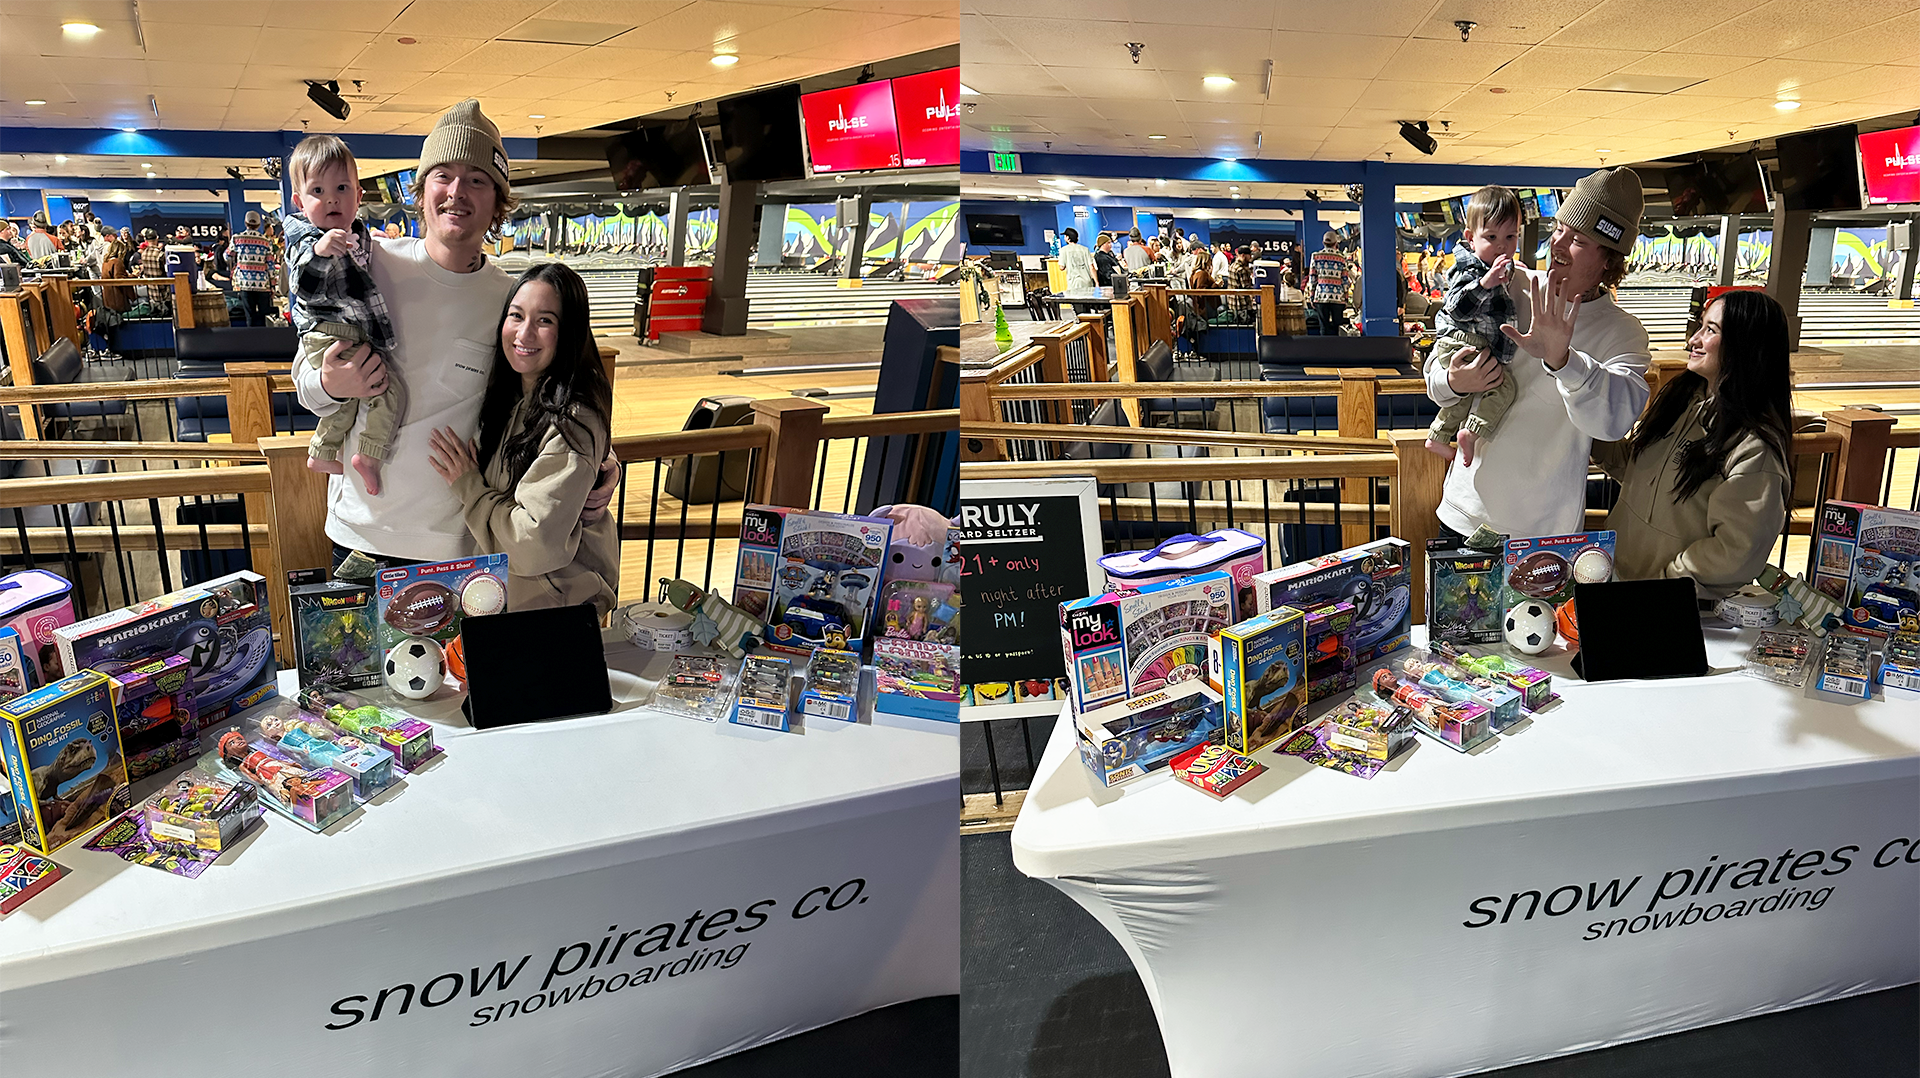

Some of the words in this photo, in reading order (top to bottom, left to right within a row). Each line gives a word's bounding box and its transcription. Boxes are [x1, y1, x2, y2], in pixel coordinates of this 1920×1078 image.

[829, 104, 868, 133] PULSE
[890, 154, 900, 167] 15
[993, 153, 1016, 171] EXIT
[1596, 219, 1622, 240] SLUSH
[745, 516, 768, 532] my
[1825, 509, 1846, 525] my
[743, 525, 777, 545] look
[987, 528, 1036, 538] SELTZER
[1823, 521, 1855, 536] look
[865, 534, 882, 543] 950
[420, 567, 436, 575] Punt,
[456, 562, 472, 570] Shoot
[1006, 556, 1040, 572] only
[321, 595, 345, 606] DRAGON
[980, 586, 1018, 609] night
[1027, 583, 1064, 599] after
[1209, 591, 1226, 600] 950
[993, 611, 1025, 629] PM!
[1744, 609, 1759, 617] TICKET
[1072, 613, 1102, 632] my
[658, 631, 673, 639] TICKET
[1074, 623, 1118, 647] look
[876, 636, 953, 653] CANDY
[876, 644, 936, 660] LAND
[1246, 652, 1263, 665] DINO
[1263, 643, 1284, 656] FOSSIL
[1126, 691, 1167, 707] SONIC
[36, 710, 60, 724] NATIONAL
[37, 711, 67, 730] GEOGRAPHIC
[29, 731, 53, 749] DINO
[53, 718, 83, 739] FOSSIL
[47, 737, 59, 748] DIG
[59, 732, 70, 743] KIT
[1186, 745, 1228, 775] UNO
[1108, 767, 1135, 781] SONIC
[1462, 875, 1643, 930] snow
[1644, 844, 1860, 913] pirates
[1582, 884, 1837, 942] snowboarding
[323, 953, 533, 1032] snow
[541, 897, 778, 990] pirates
[791, 877, 871, 920] co.
[468, 941, 752, 1028] snowboarding
